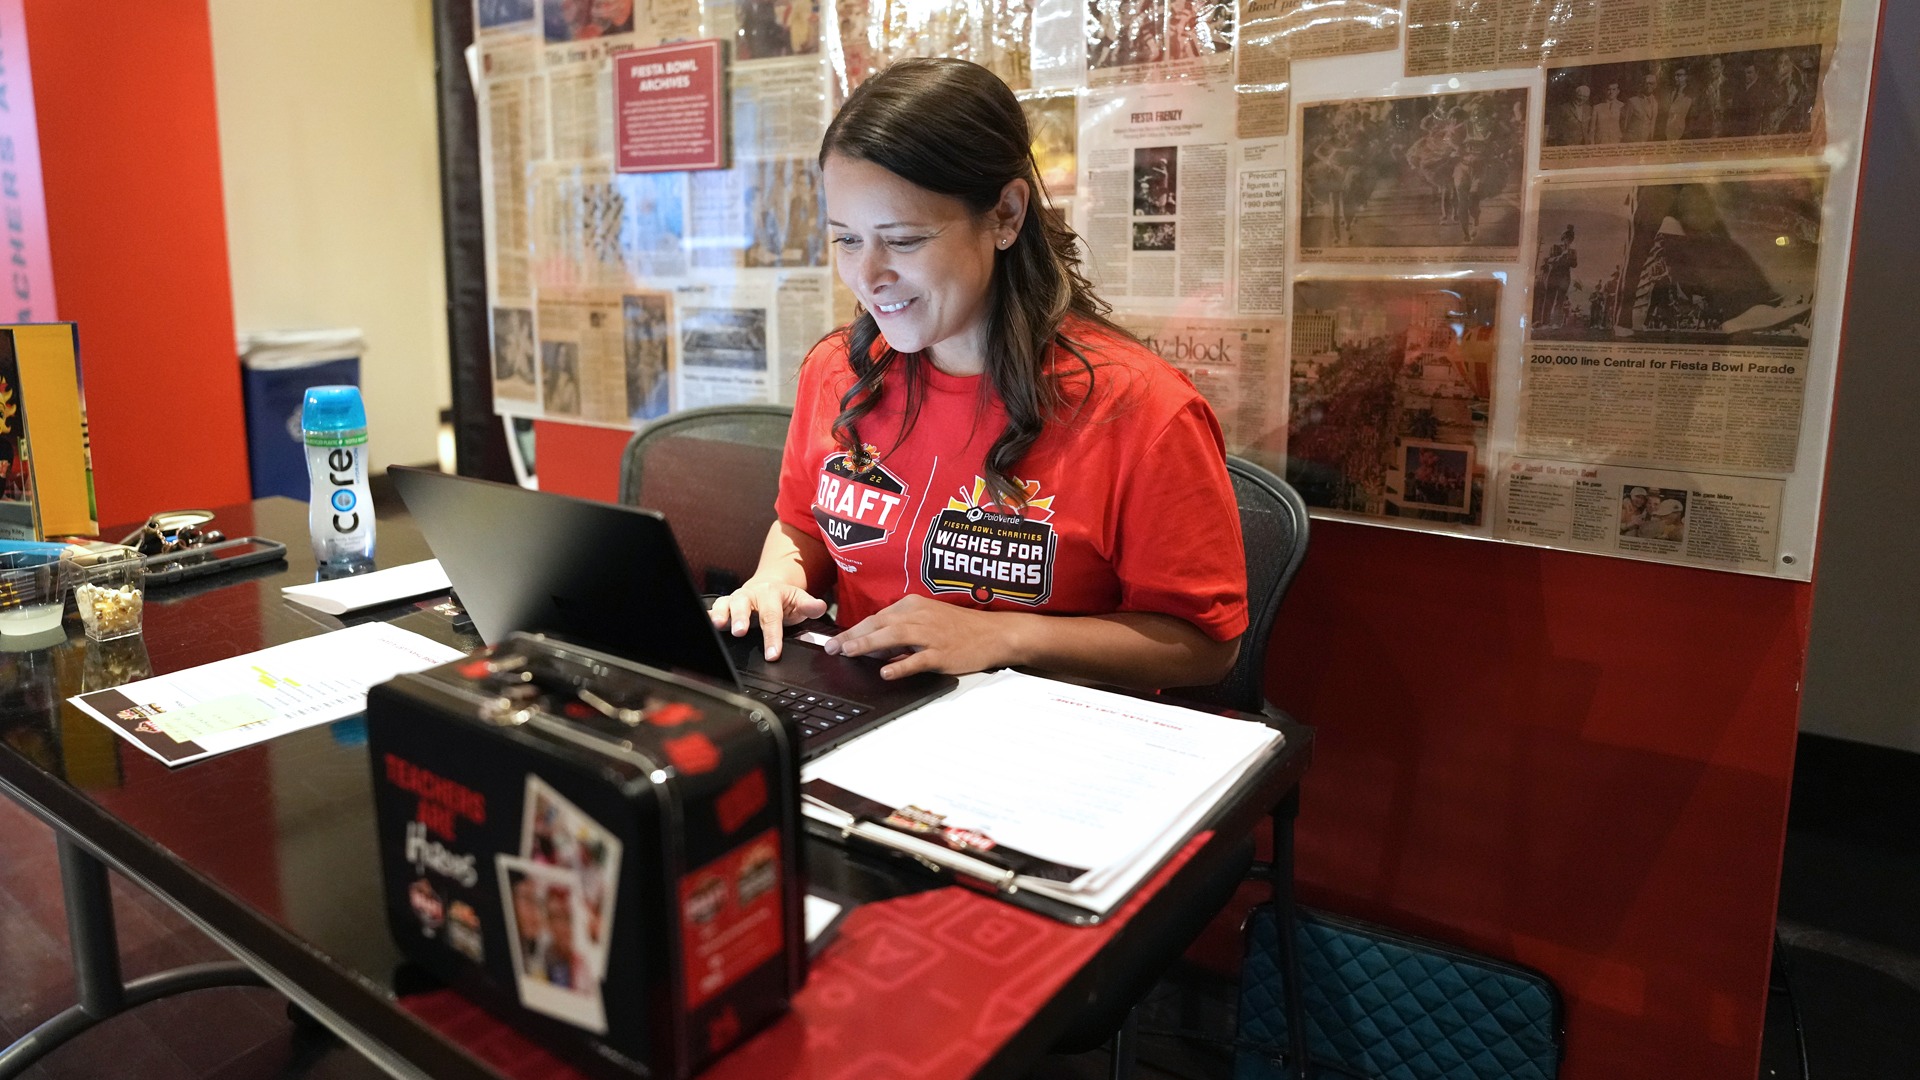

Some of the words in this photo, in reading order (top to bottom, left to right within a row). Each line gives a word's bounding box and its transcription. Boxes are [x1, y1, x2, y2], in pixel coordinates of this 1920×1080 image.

[631, 62, 665, 79] FIESTA
[666, 59, 699, 74] BOWL
[639, 76, 691, 92] ARCHIVES
[1131, 112, 1154, 124] FIESTA
[1156, 109, 1183, 123] FRENZY
[1246, 181, 1270, 192] figures
[1271, 181, 1279, 189] in
[1248, 172, 1278, 181] Prescott
[1242, 191, 1264, 200] Fiesta
[1265, 189, 1283, 199] Bowl
[1244, 200, 1262, 209] 1990
[1176, 335, 1231, 362] block
[1531, 354, 1578, 366] 200,000
[1581, 356, 1600, 366] line
[1604, 357, 1645, 369] Central
[1650, 359, 1667, 369] for
[1670, 360, 1708, 371] Fiesta
[1712, 361, 1743, 373] Bowl
[1748, 362, 1796, 374] Parade
[869, 474, 882, 484] 22
[328, 448, 359, 534] core
[818, 475, 901, 525] DRAFT
[828, 518, 852, 541] DAY
[943, 521, 969, 531] FIESTA
[972, 525, 994, 535] BOWL
[997, 529, 1043, 542] CHARITIES
[935, 528, 1003, 557] WISHES
[1008, 542, 1043, 561] FOR
[932, 549, 1041, 585] TEACHERS
